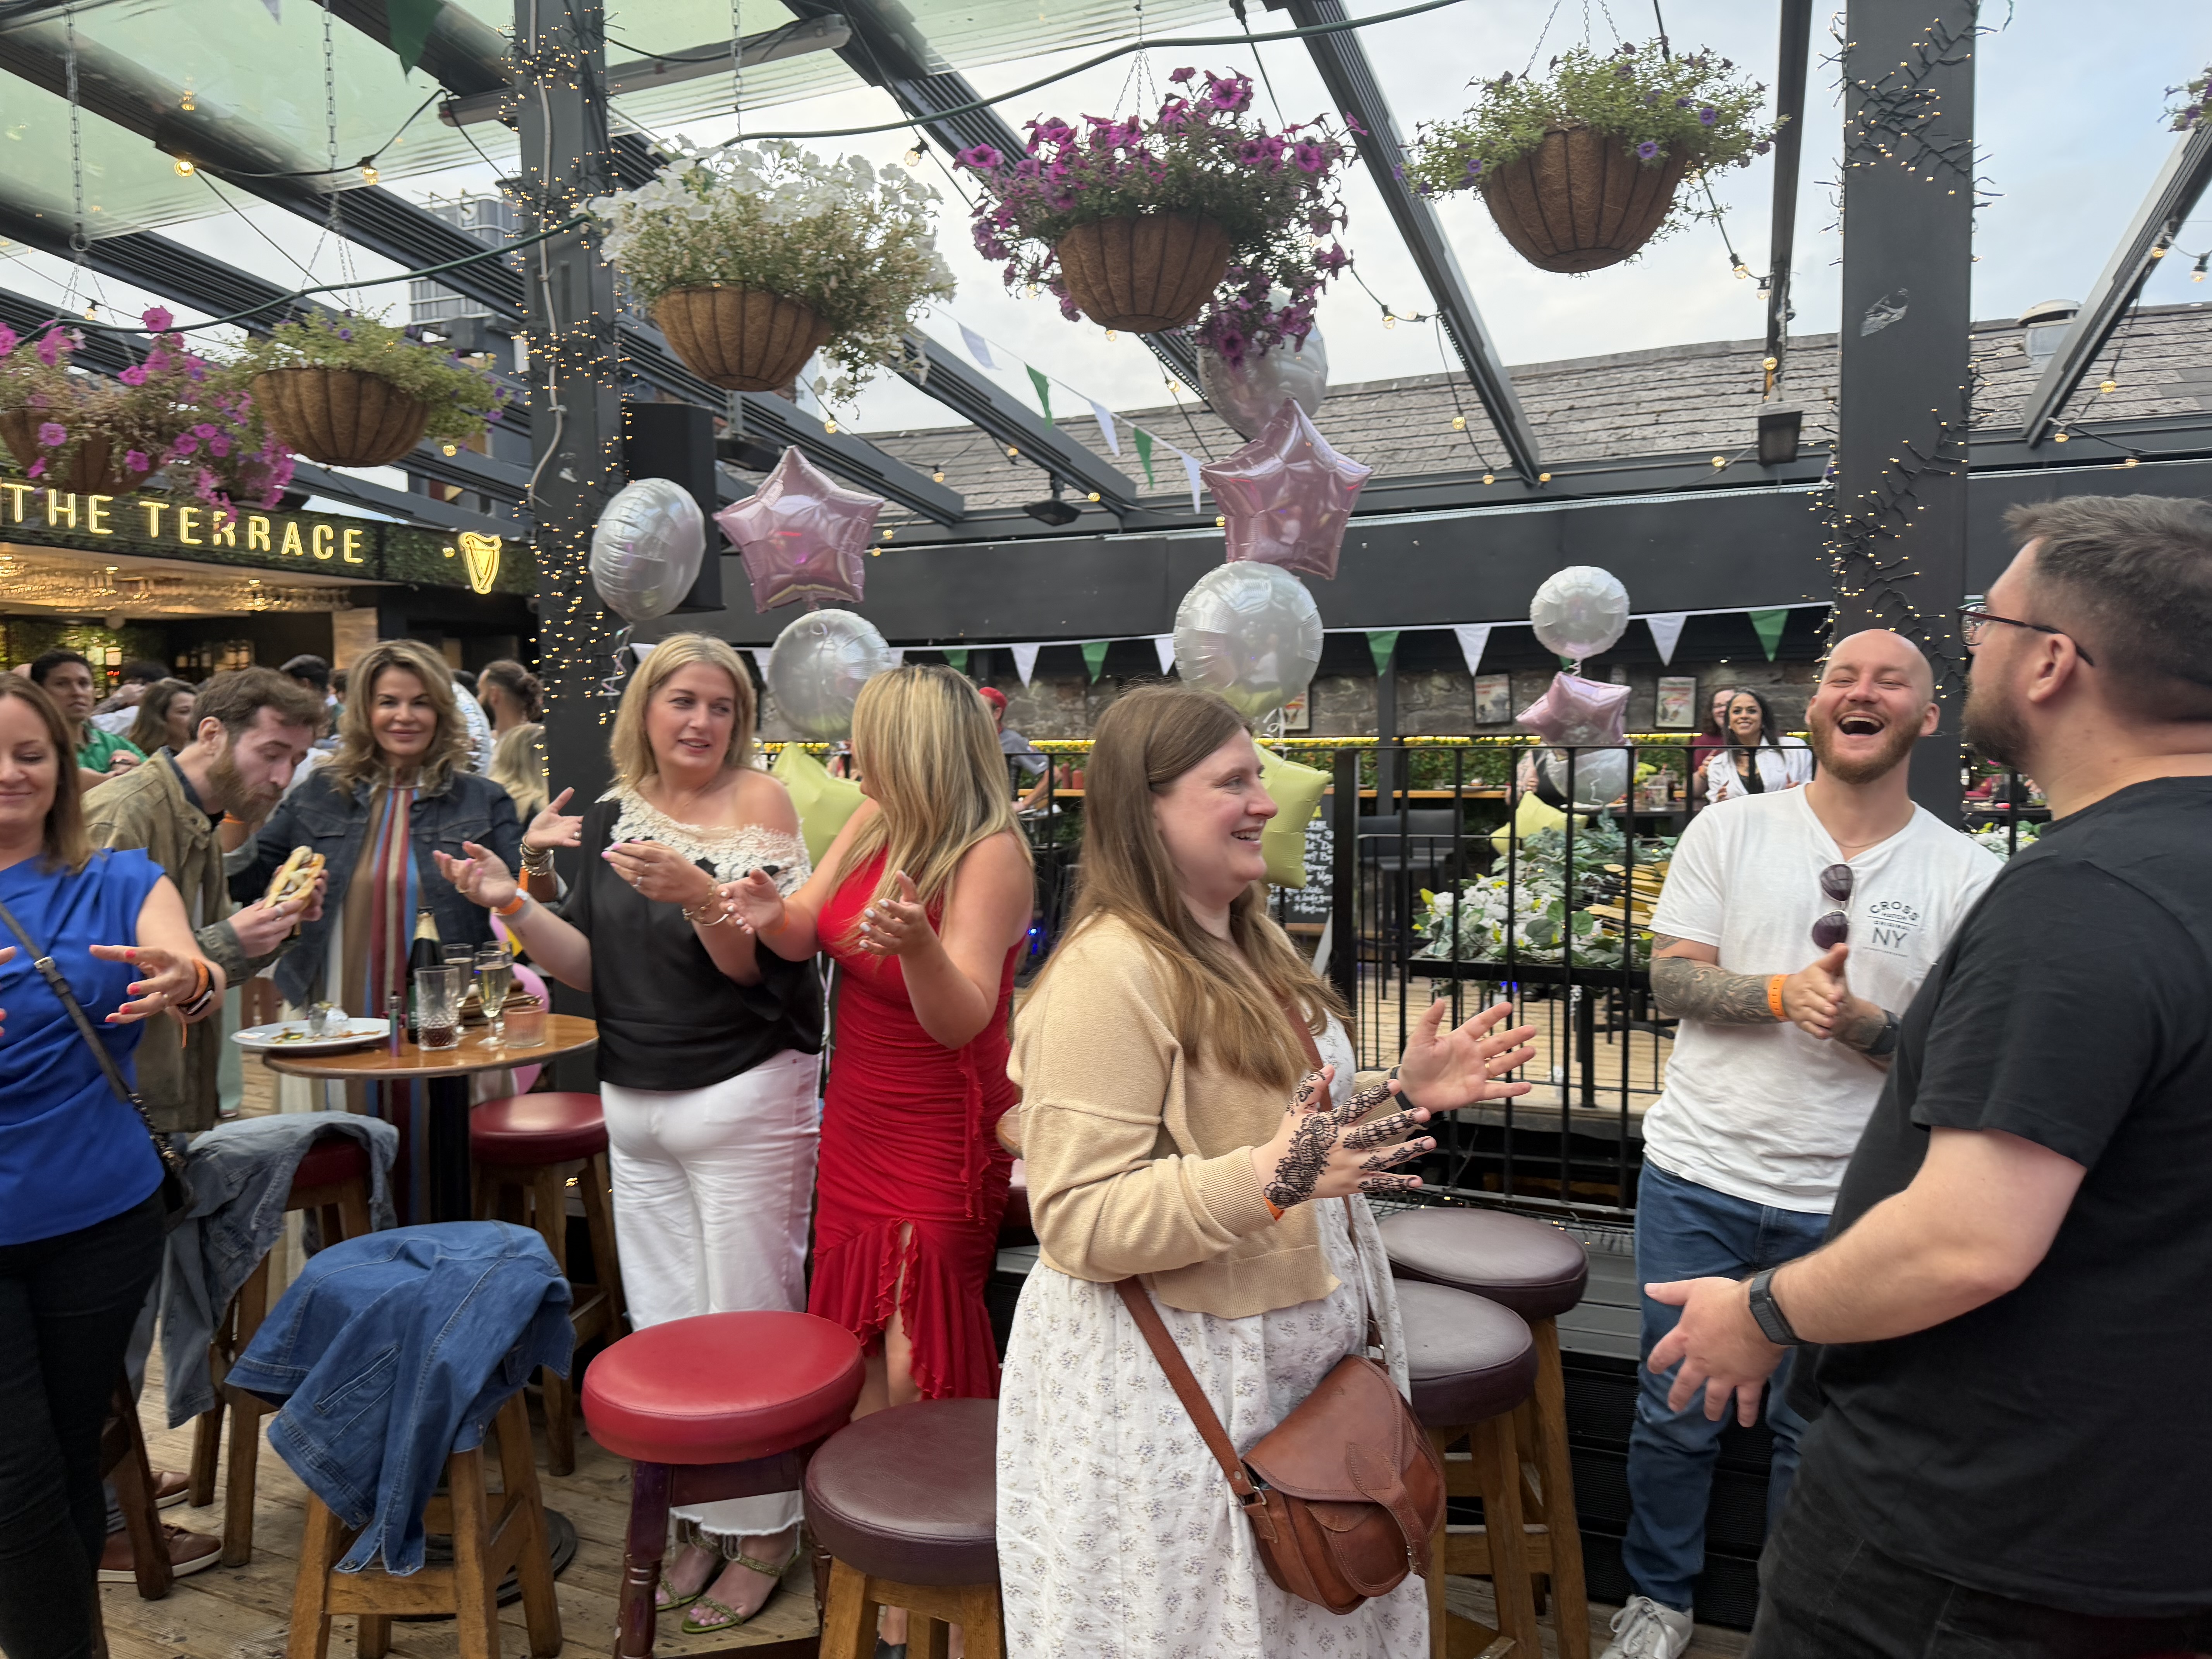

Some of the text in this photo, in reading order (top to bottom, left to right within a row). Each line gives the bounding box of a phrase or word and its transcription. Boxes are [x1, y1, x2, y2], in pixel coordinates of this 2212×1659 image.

[1, 483, 364, 563] THE TERRACE
[1870, 901, 1920, 921] CROSS
[1872, 927, 1908, 948] NY
